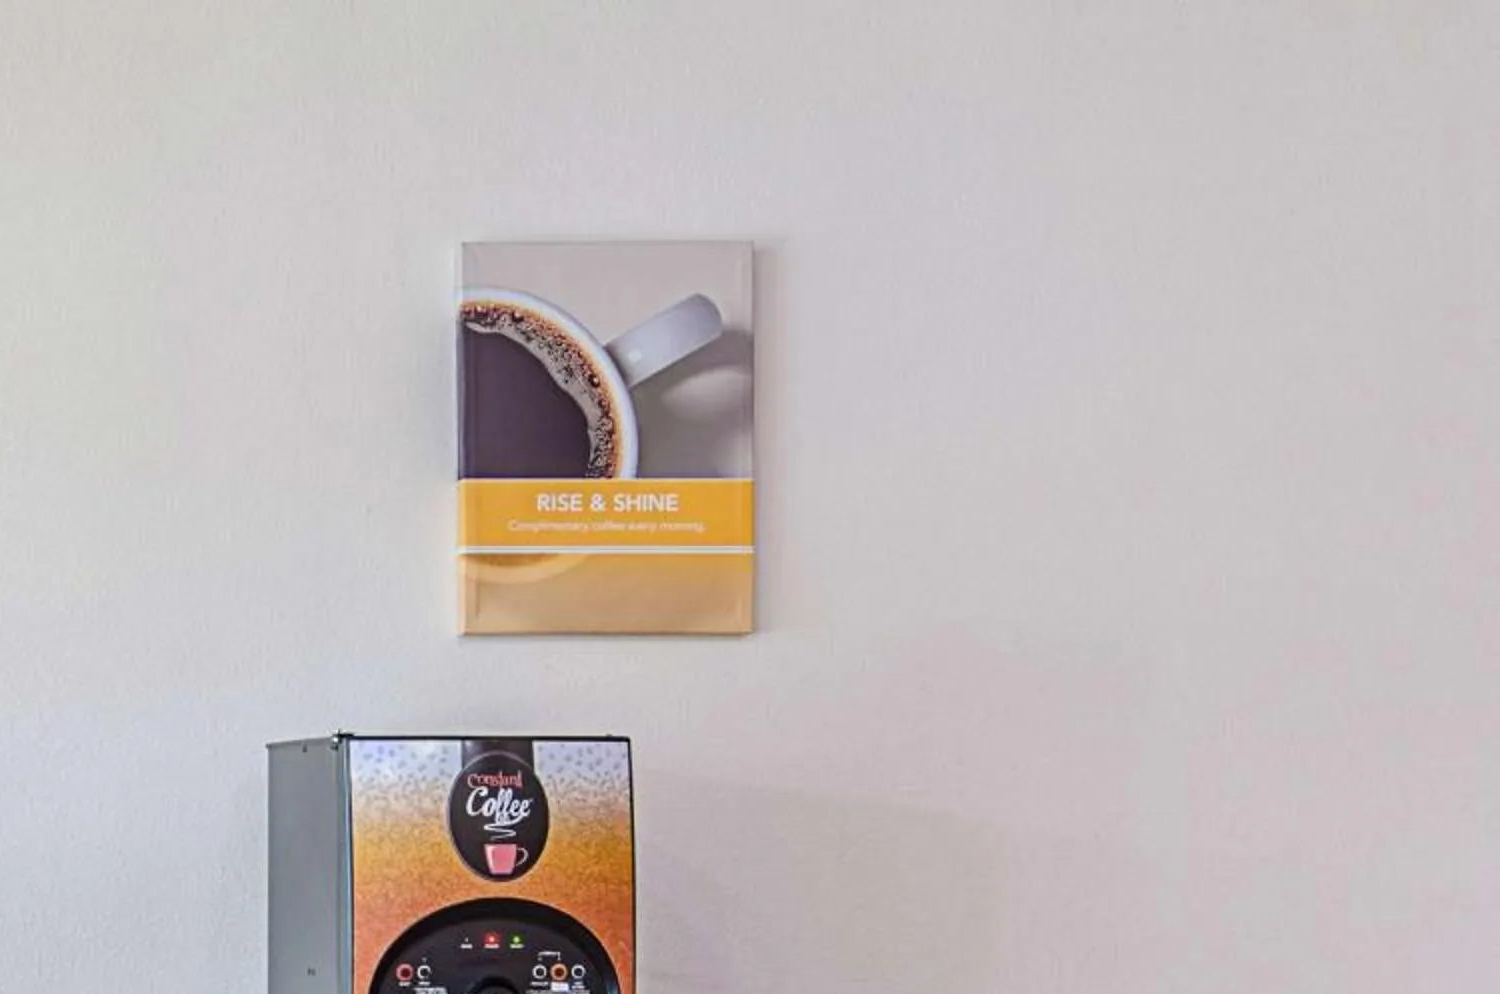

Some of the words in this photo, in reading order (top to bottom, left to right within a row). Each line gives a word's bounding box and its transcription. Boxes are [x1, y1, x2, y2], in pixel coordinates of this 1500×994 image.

[536, 493, 583, 512] RISE
[590, 494, 606, 512] &
[613, 493, 679, 512] SHINE
[507, 519, 589, 534] Complimentary
[592, 519, 627, 532] coffee
[628, 521, 657, 533] every
[465, 786, 534, 826] Coffee
